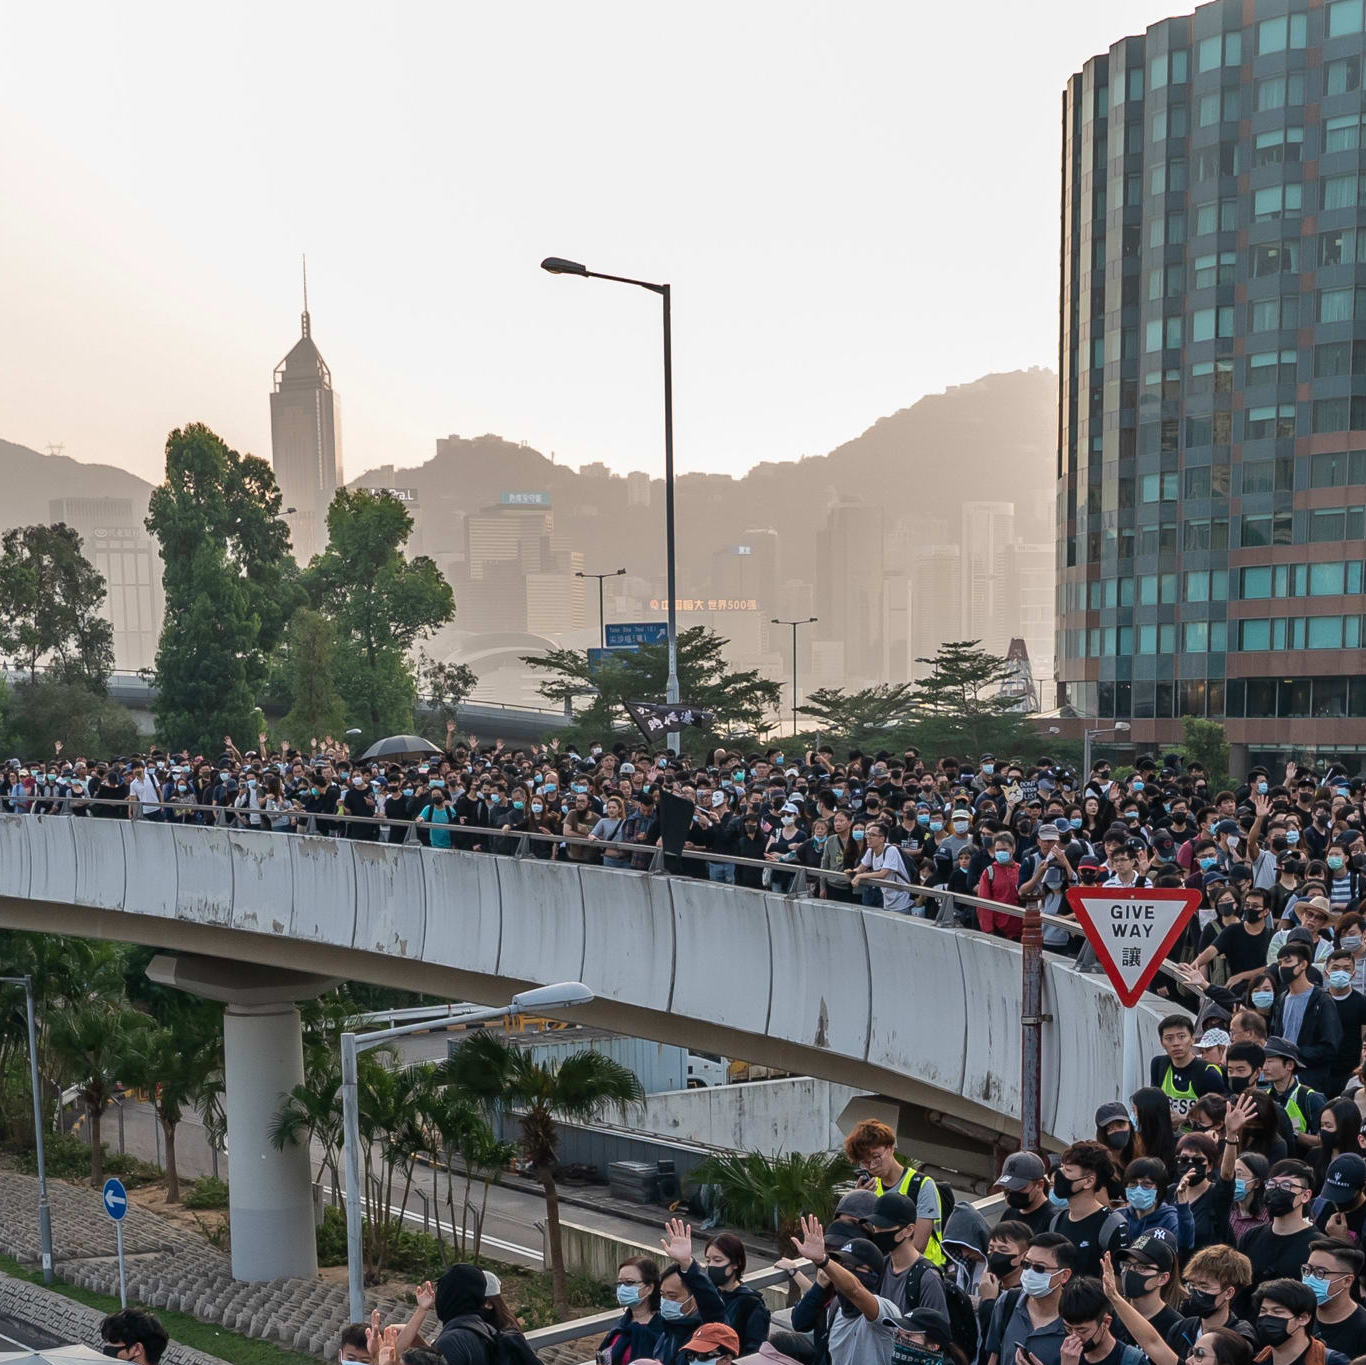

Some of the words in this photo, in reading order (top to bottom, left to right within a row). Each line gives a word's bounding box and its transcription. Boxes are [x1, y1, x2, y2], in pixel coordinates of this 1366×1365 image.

[1110, 905, 1155, 920] GIVE
[1111, 923, 1154, 938] WAY
[1122, 947, 1141, 967] 讓
